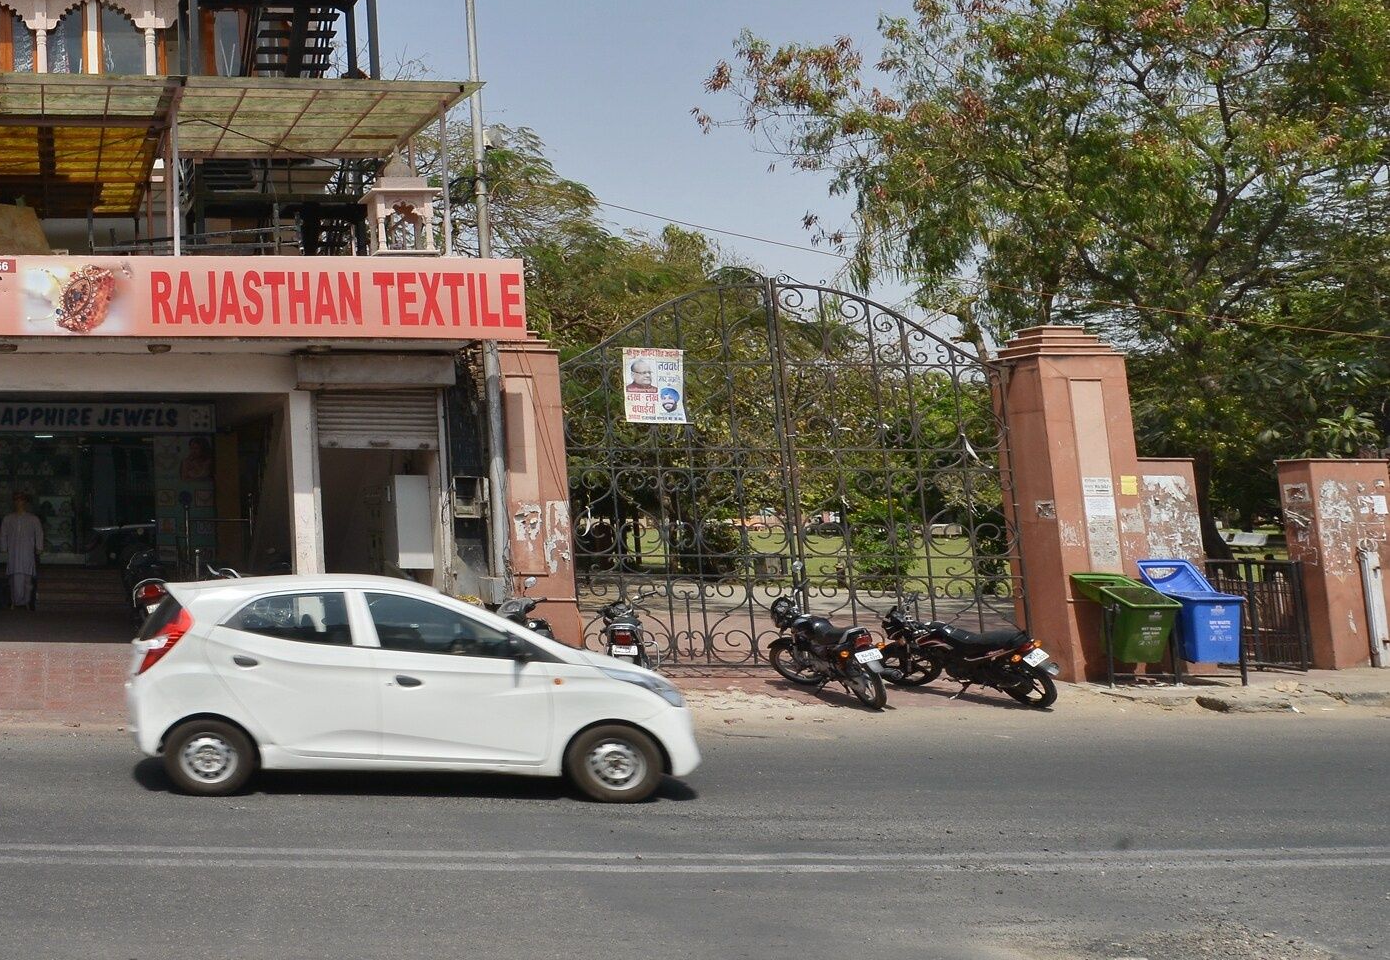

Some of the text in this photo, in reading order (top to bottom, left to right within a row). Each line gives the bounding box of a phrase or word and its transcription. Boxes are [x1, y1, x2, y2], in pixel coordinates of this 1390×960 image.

[150, 269, 523, 328] RAJASTHAN TEXTILE
[97, 406, 179, 428] JEWELS
